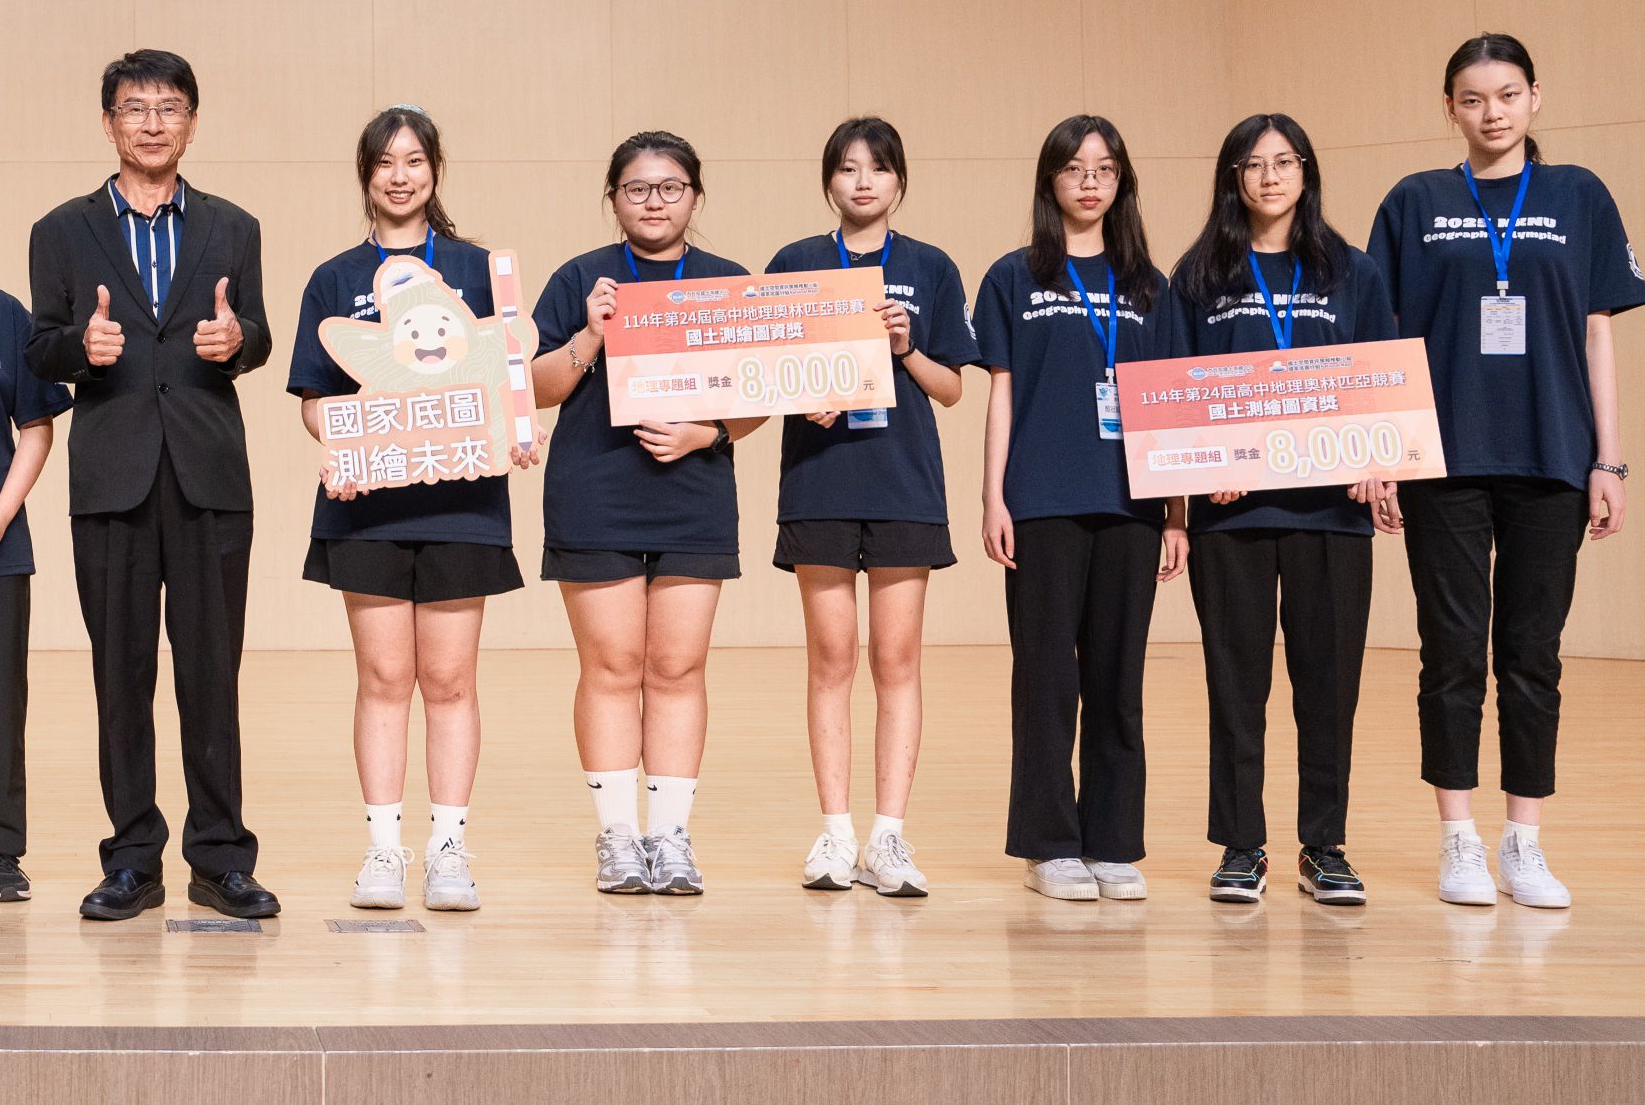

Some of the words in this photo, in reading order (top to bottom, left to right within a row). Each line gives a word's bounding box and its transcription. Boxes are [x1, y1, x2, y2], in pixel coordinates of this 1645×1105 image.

[1423, 230, 1496, 243] Geograph
[623, 299, 865, 329] 114年第24屆高中地理奧林匹亞競賽
[1022, 306, 1088, 320] Geography
[1277, 308, 1336, 324] Oympiad
[686, 322, 804, 347] 國土測繪圖資獎
[708, 375, 732, 388] 獎金
[738, 351, 858, 406] 8,000
[863, 380, 875, 391] 元
[1141, 370, 1406, 405] 114年第24屆高中地理奧林匹亞競賽
[322, 388, 485, 440] 國家底圖
[1208, 395, 1339, 421] 國土測繪圖資獎
[328, 436, 491, 487] 測繪未來
[1234, 447, 1261, 461] 獎金
[1266, 421, 1403, 478] 8,000
[1407, 449, 1421, 461] 元
